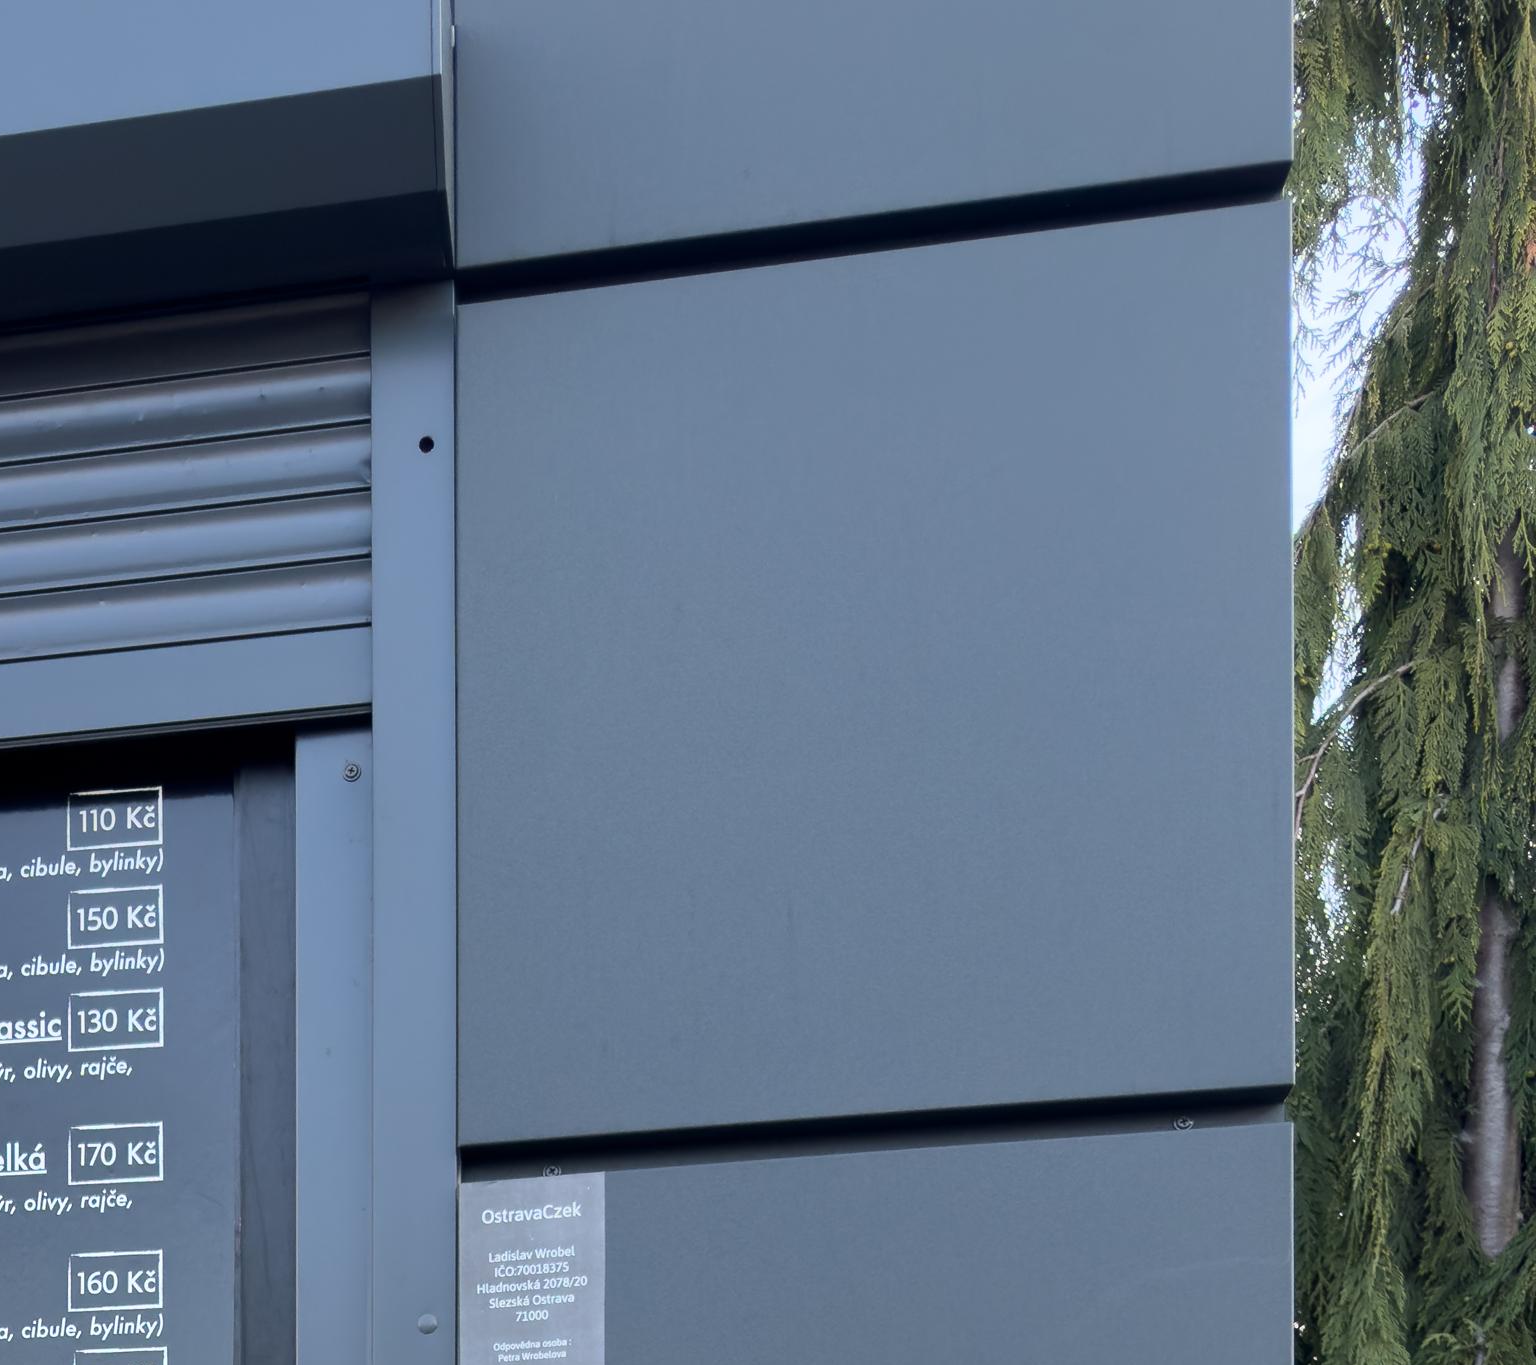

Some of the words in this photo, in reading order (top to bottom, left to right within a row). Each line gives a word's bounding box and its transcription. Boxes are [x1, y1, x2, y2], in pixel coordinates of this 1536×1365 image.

[80, 808, 115, 832] 110
[127, 806, 155, 829] Kč
[21, 856, 81, 878] cibule,
[90, 849, 163, 877] bylinky)
[77, 907, 118, 931] 150
[128, 905, 156, 928] Kč
[21, 955, 81, 977] cibule,
[90, 948, 164, 976] bylinky)
[78, 1009, 117, 1033] 130
[128, 1008, 156, 1032] Kč
[24, 1059, 72, 1083] olivy,
[81, 1055, 132, 1081] rajče,
[78, 1143, 116, 1166] 170
[128, 1142, 156, 1165] Kč
[24, 1192, 72, 1216] olivy,
[81, 1189, 132, 1213] rajče,
[482, 1201, 582, 1224] OstravaCzek
[488, 1248, 533, 1263] Ladislav
[535, 1245, 575, 1259] Wrobel
[494, 1261, 569, 1277] IČO:70018375
[78, 1271, 118, 1294] 160
[128, 1270, 155, 1293] Kč
[477, 1279, 541, 1294] Hladnovská
[543, 1275, 588, 1289] 2078/20
[489, 1295, 530, 1309] Slezská
[532, 1294, 575, 1305] Ostrava
[22, 1318, 81, 1339] cibule,
[90, 1315, 163, 1341] bylinky)
[516, 1310, 549, 1322] 71000
[498, 1353, 520, 1363] Petra
